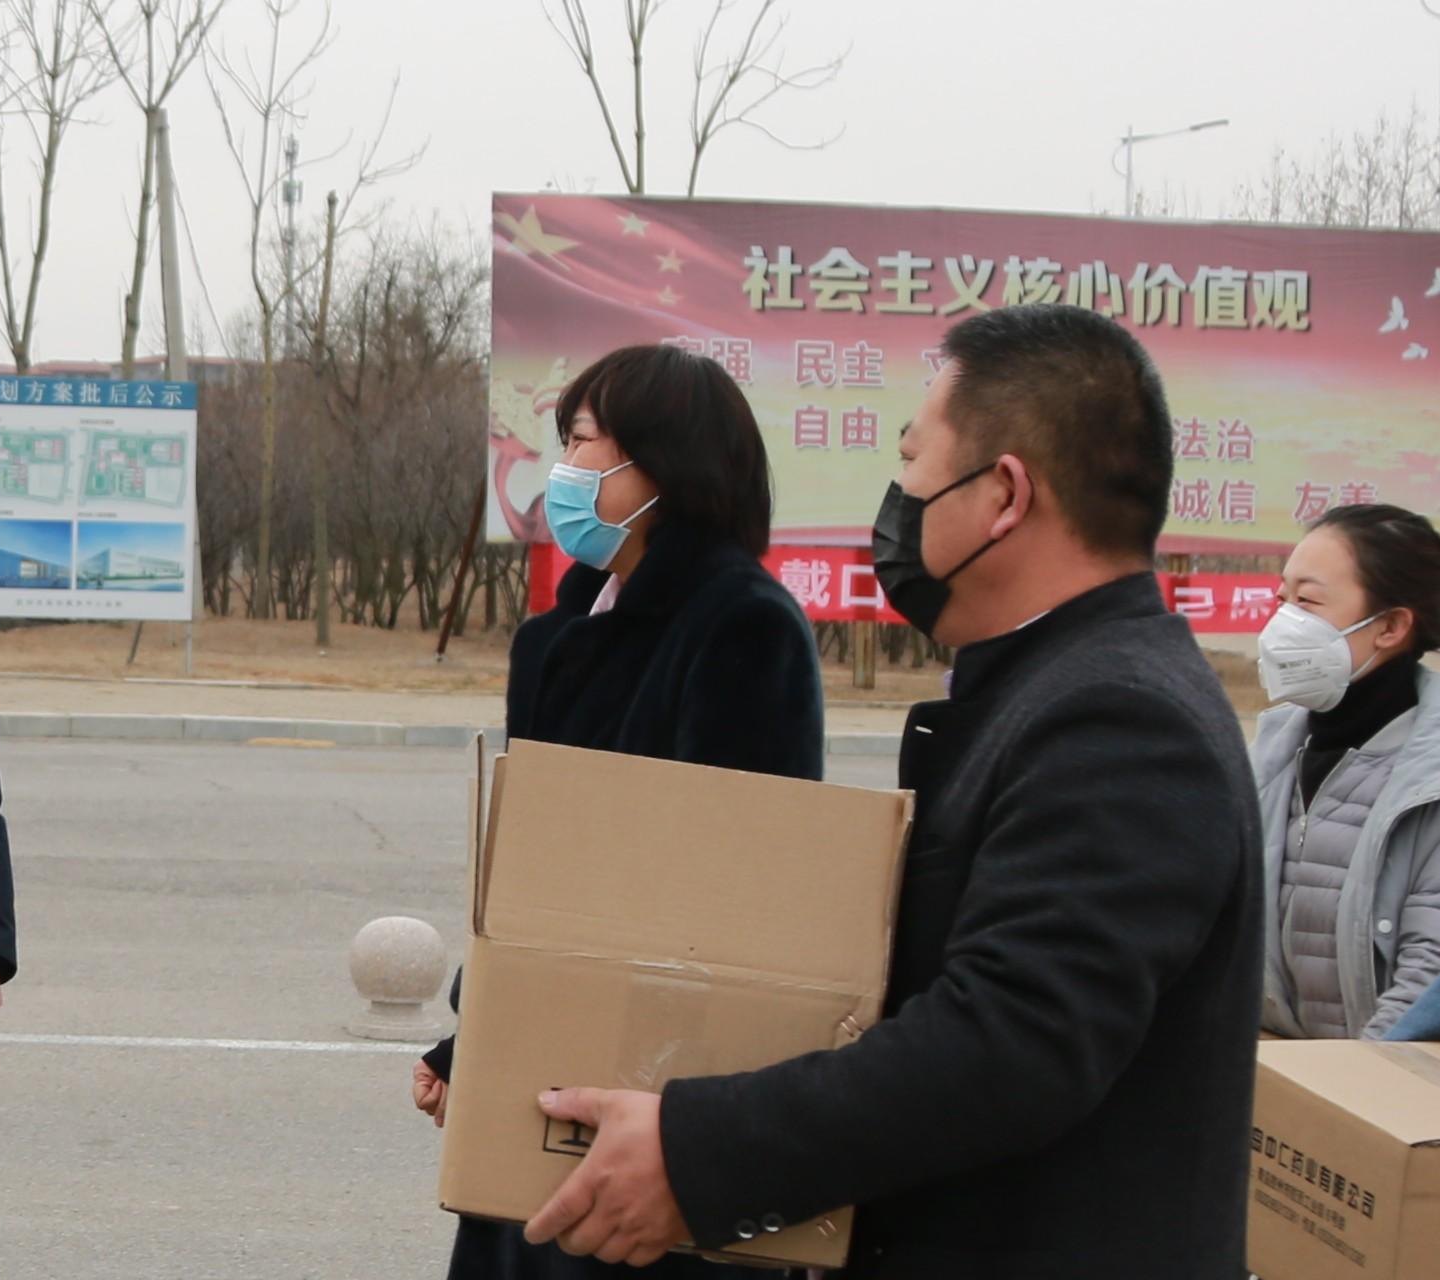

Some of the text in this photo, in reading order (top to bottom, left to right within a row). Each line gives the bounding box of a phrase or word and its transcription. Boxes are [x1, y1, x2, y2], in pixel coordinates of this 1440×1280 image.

[742, 245, 1311, 330] 社会主义核心价值观
[794, 339, 883, 385] 民主
[794, 405, 1256, 461] 自由 法治
[1171, 479, 1257, 521] 诚信
